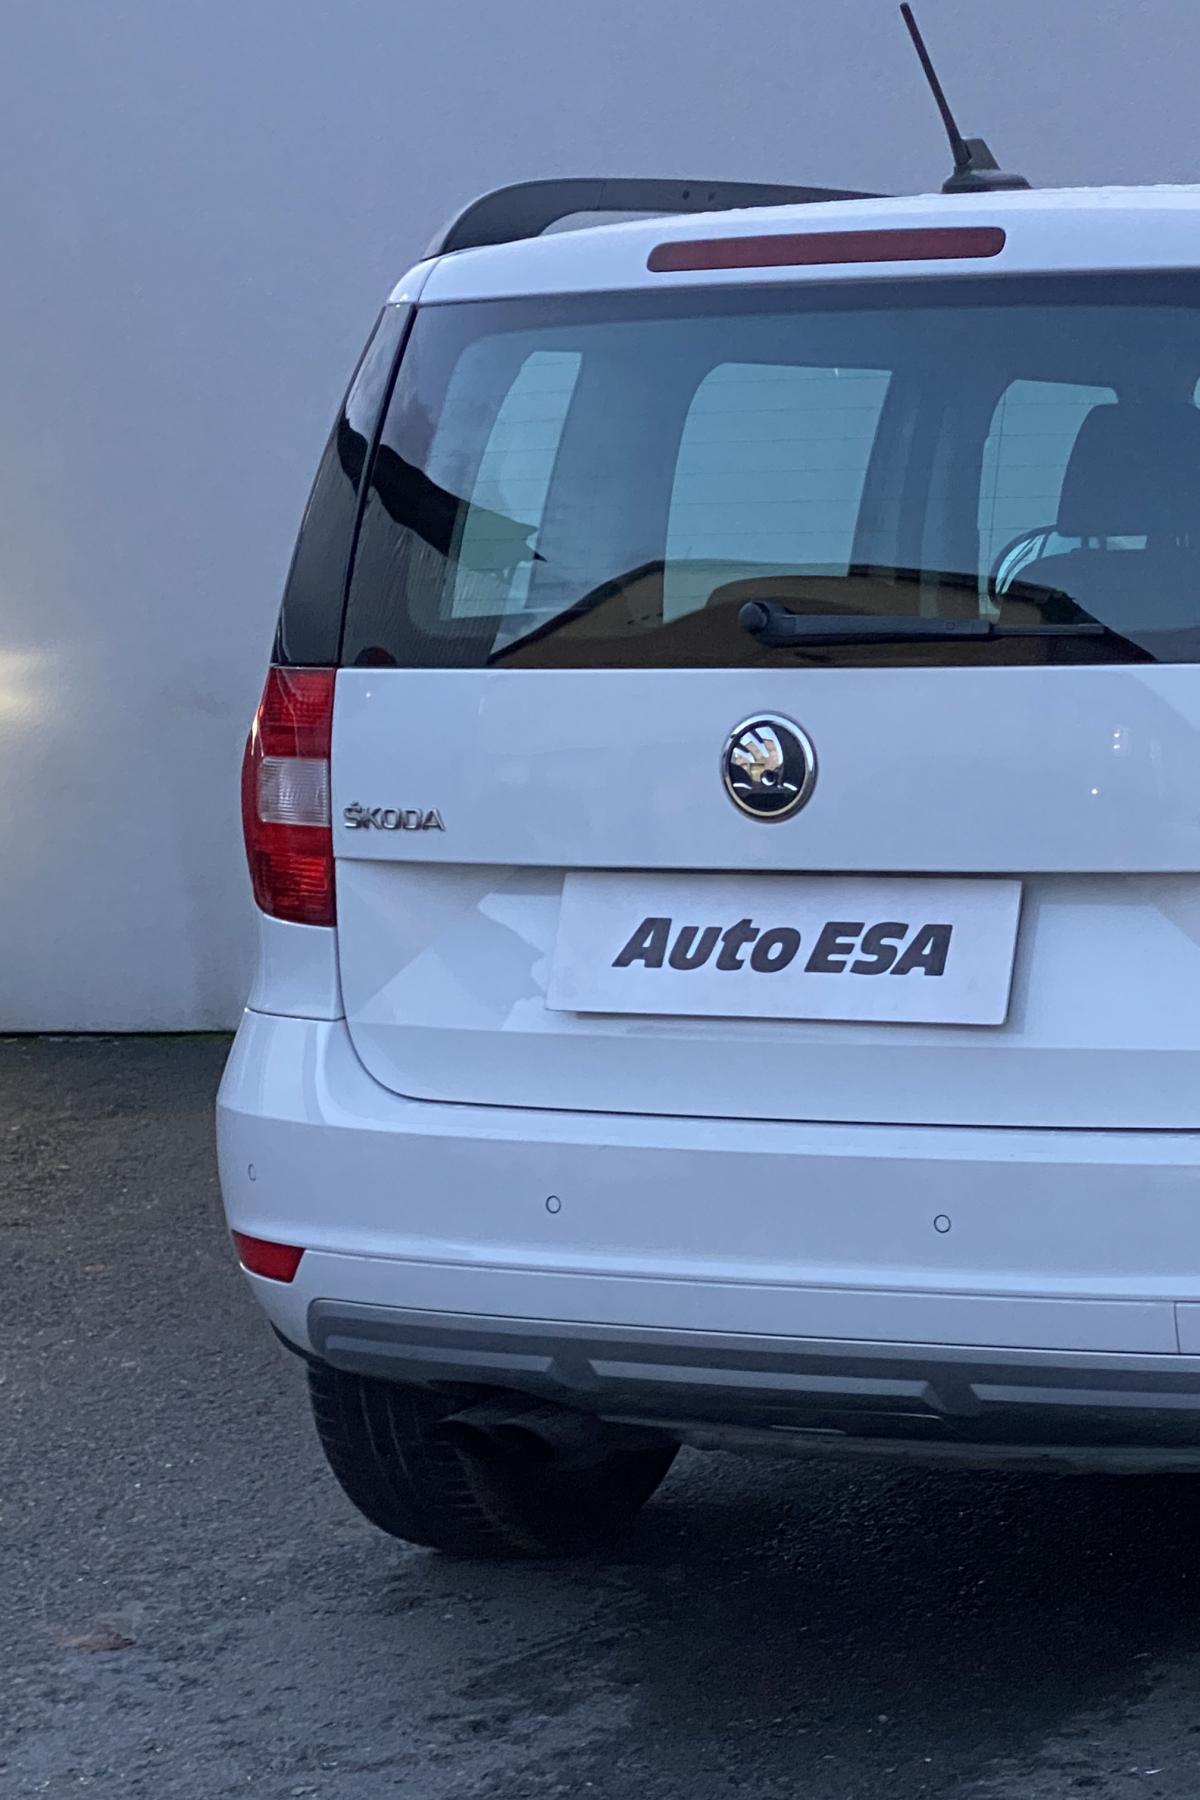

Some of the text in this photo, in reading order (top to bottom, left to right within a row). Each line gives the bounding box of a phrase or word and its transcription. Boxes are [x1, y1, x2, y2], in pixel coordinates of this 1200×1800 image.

[343, 801, 446, 832] ŠKODA
[612, 917, 954, 977] Auto ESA
